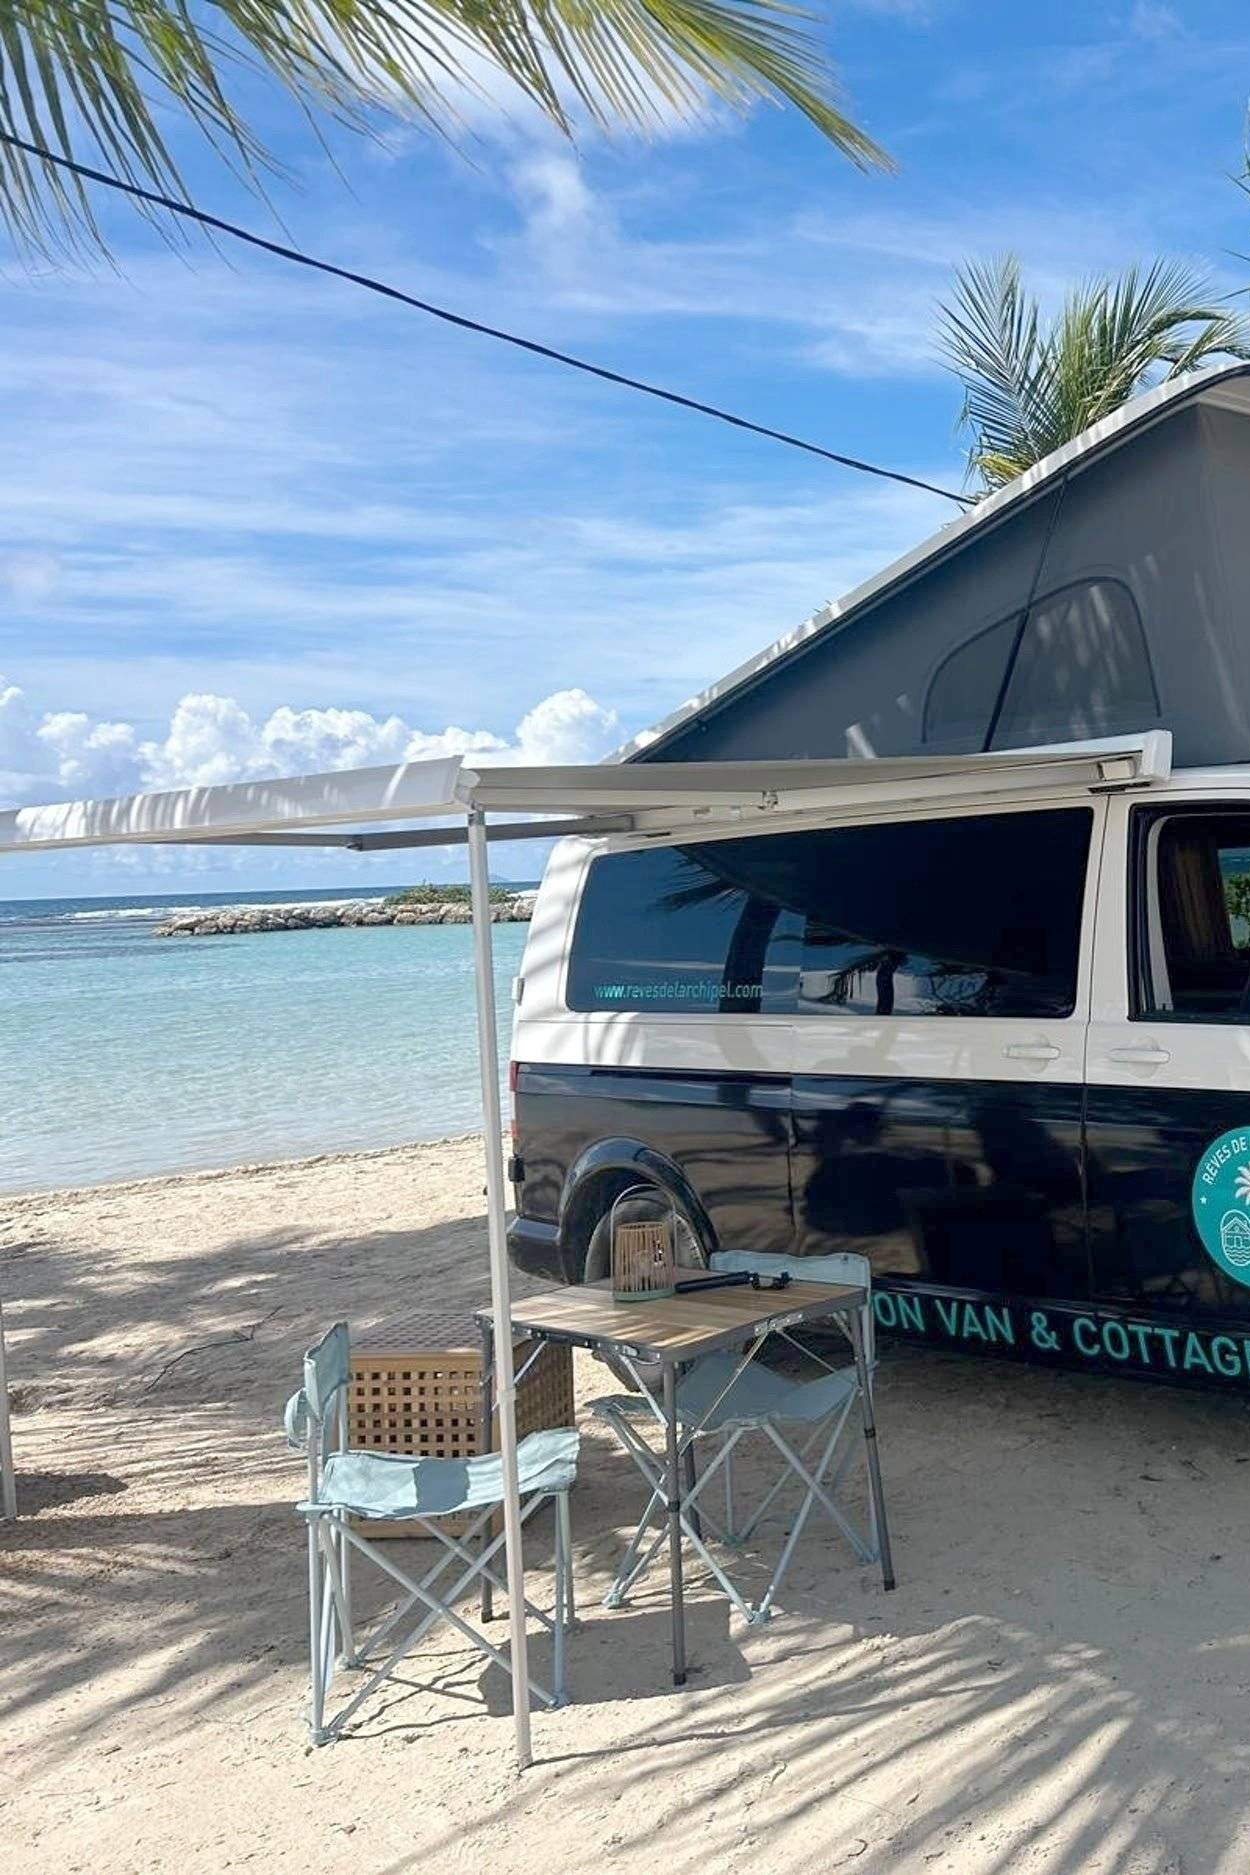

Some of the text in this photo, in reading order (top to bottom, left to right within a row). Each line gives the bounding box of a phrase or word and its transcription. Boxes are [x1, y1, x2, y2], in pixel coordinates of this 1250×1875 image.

[594, 980, 764, 1001] www.revesdelarchipel.com
[1231, 1136, 1248, 1154] DE
[935, 1299, 1015, 1344] VAN
[1031, 1311, 1062, 1351] &
